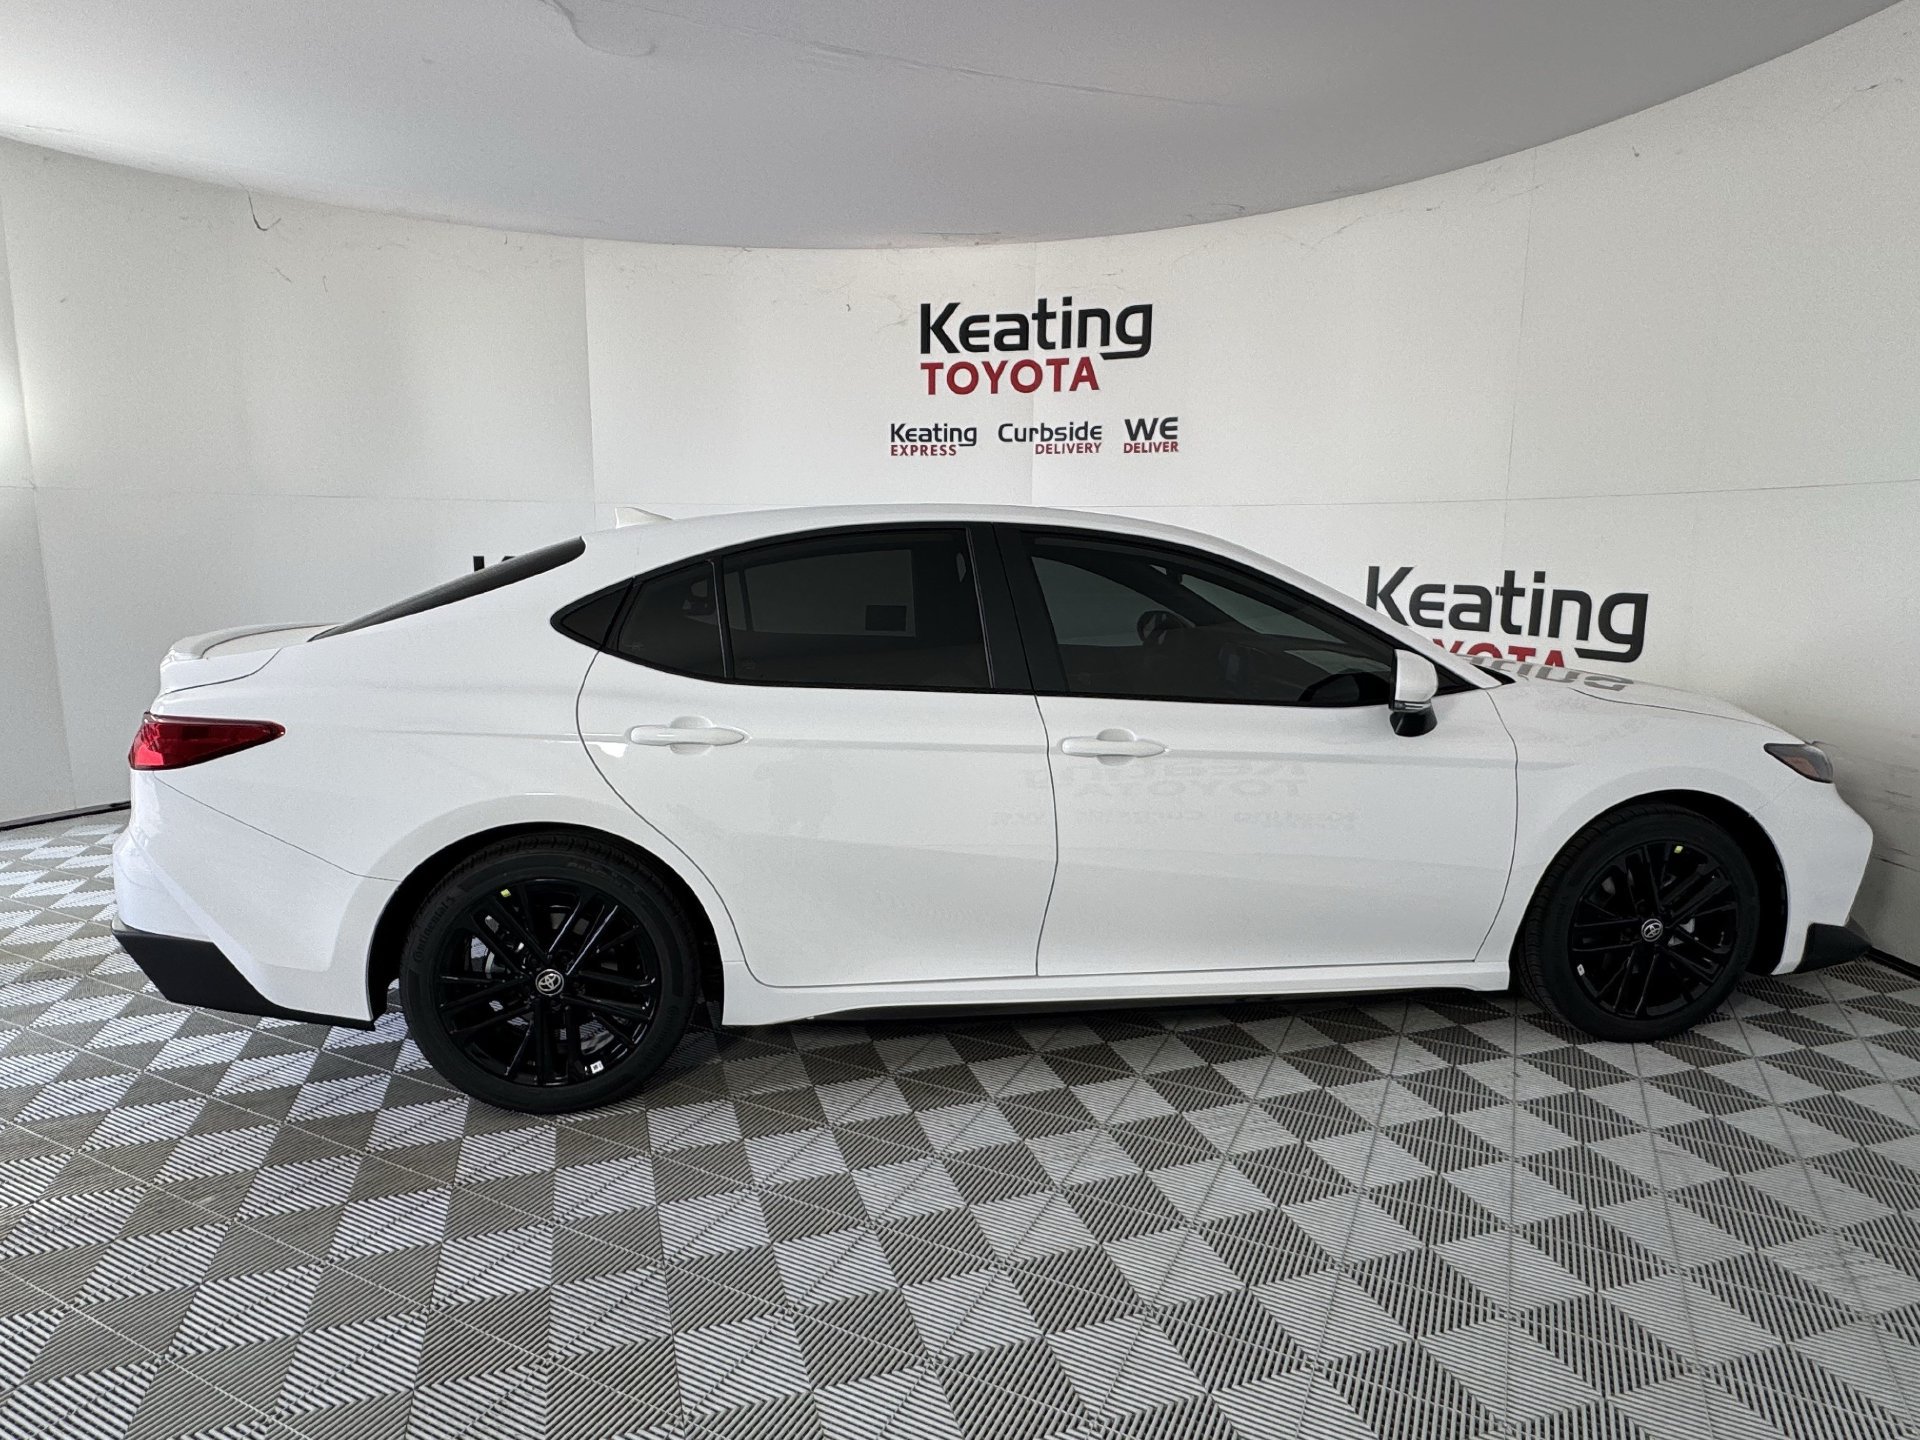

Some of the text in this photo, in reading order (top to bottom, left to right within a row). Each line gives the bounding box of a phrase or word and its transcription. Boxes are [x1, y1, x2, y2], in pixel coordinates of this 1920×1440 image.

[920, 295, 1153, 361] Keating
[920, 356, 1100, 396] TOYOTA
[890, 422, 977, 447] Keating
[997, 420, 1103, 443] Curbside
[1124, 416, 1179, 442] WE
[890, 445, 957, 457] EXPRESS
[1034, 442, 1103, 456] DELIVERY
[1123, 441, 1180, 454] DELIVER
[1366, 565, 1649, 664] Keating
